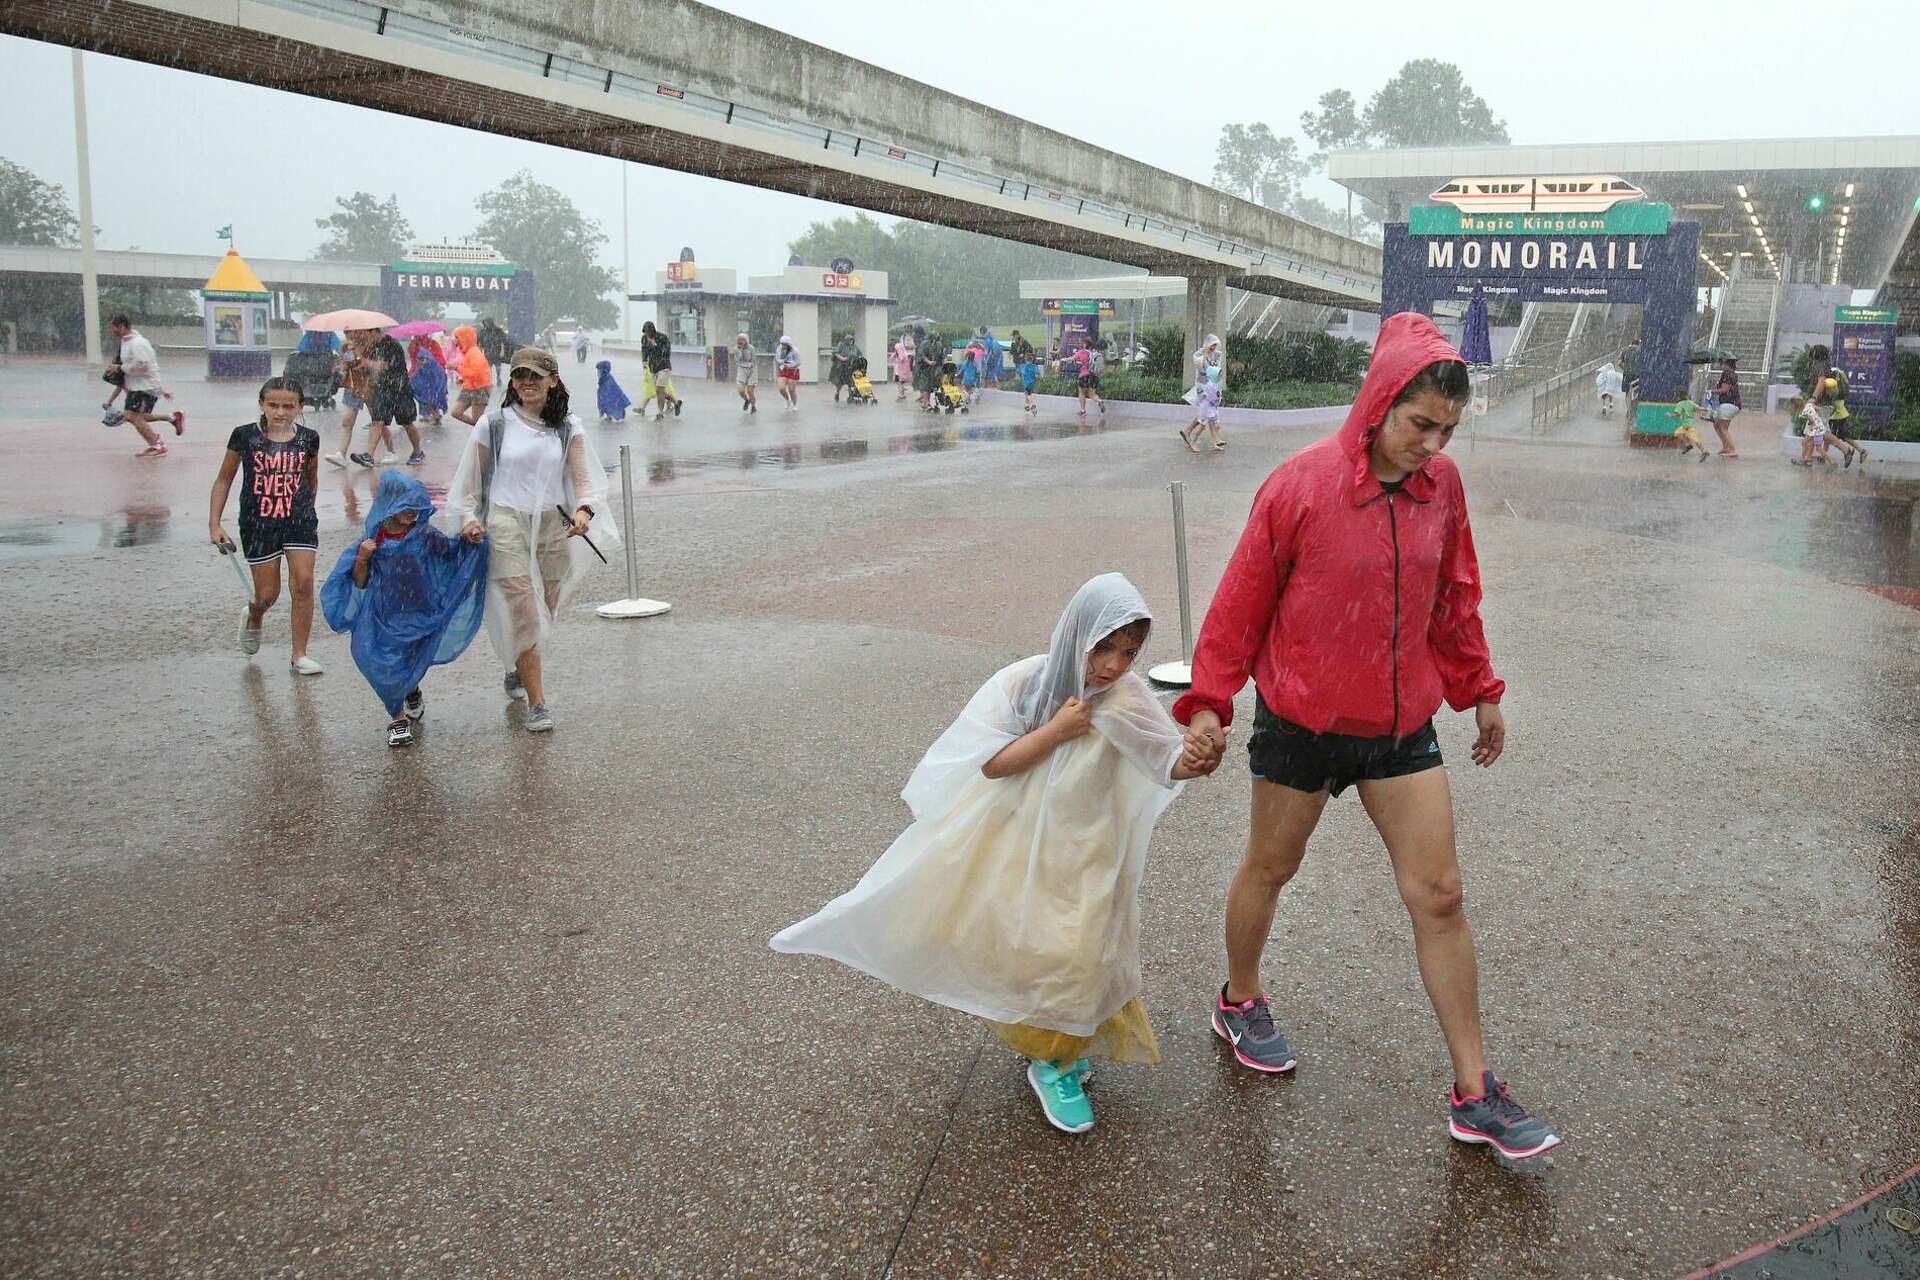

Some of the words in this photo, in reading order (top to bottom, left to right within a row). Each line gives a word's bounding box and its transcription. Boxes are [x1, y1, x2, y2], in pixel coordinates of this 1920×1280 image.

[1461, 218, 1514, 231] Magic
[1523, 218, 1605, 231] Kingdom
[1428, 241, 1643, 270] MONORAIL
[397, 273, 512, 290] FERRYBOAT
[1482, 285, 1519, 295] Kingdom
[1543, 286, 1569, 295] Magic
[1570, 286, 1609, 296] Kingdom
[254, 450, 306, 473] SMILE
[253, 472, 302, 497] EVERY
[259, 496, 293, 518] DAY
